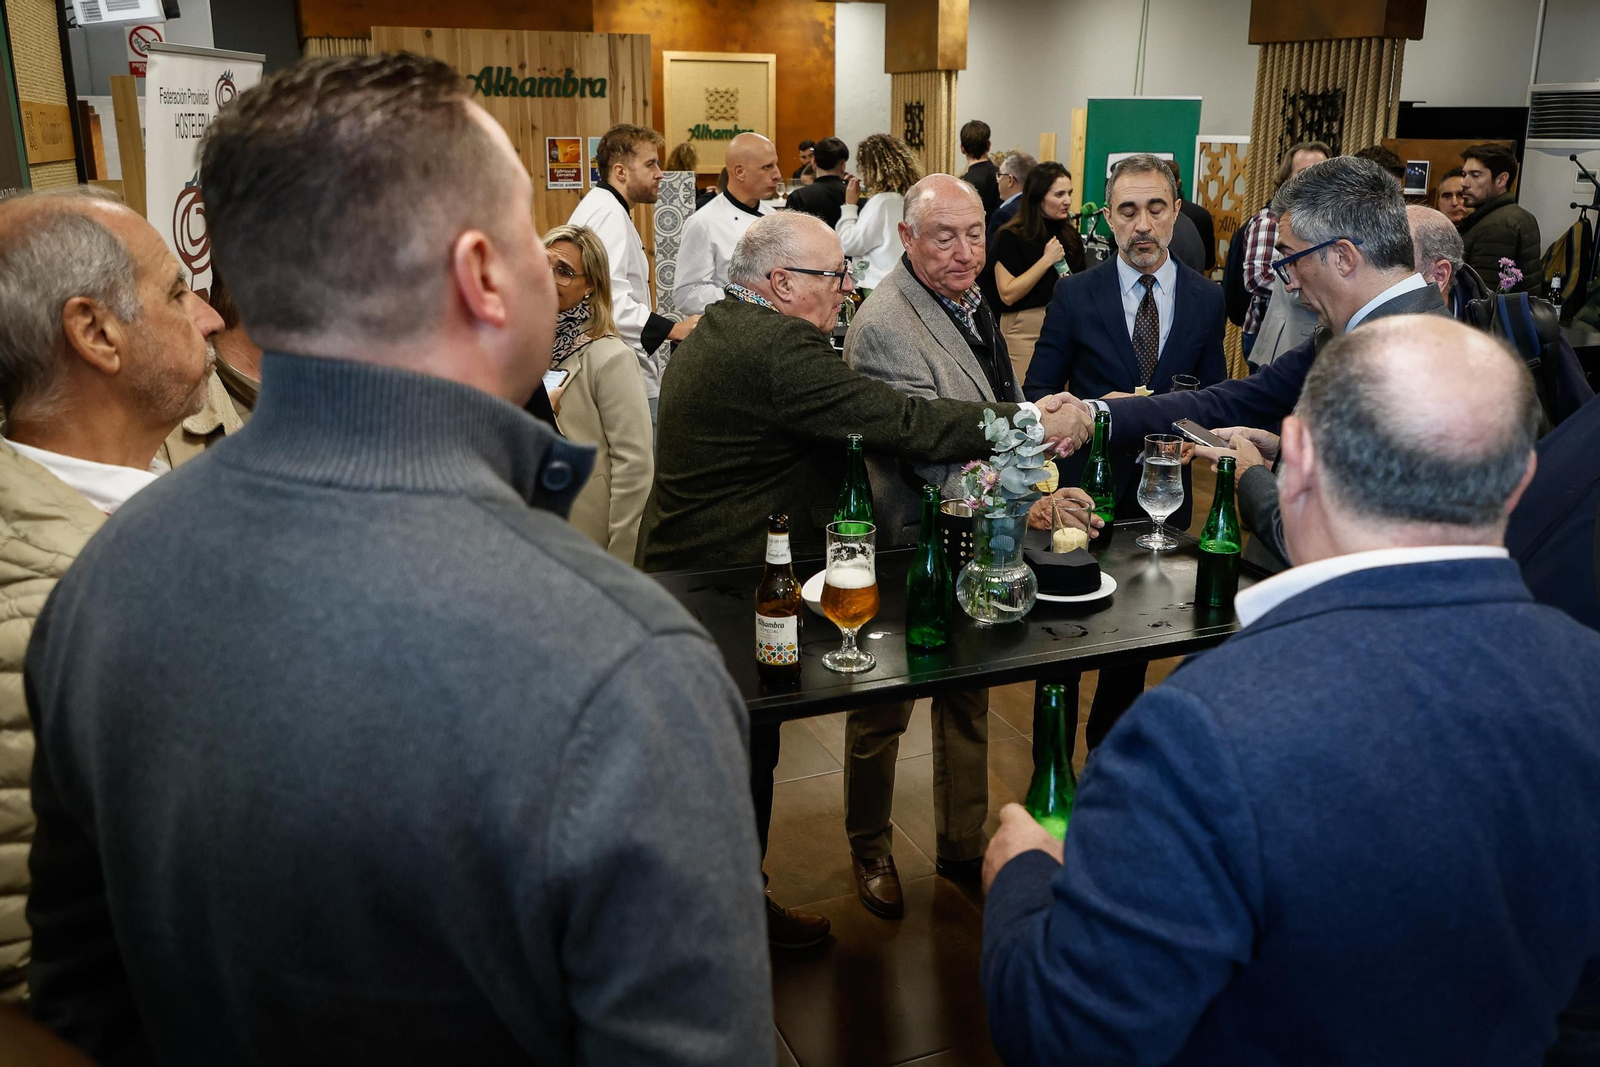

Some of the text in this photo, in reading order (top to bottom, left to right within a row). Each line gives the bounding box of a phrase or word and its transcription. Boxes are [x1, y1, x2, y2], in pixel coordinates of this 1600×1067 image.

[466, 66, 607, 98] Alhambra
[160, 87, 210, 105] Federación Provincial
